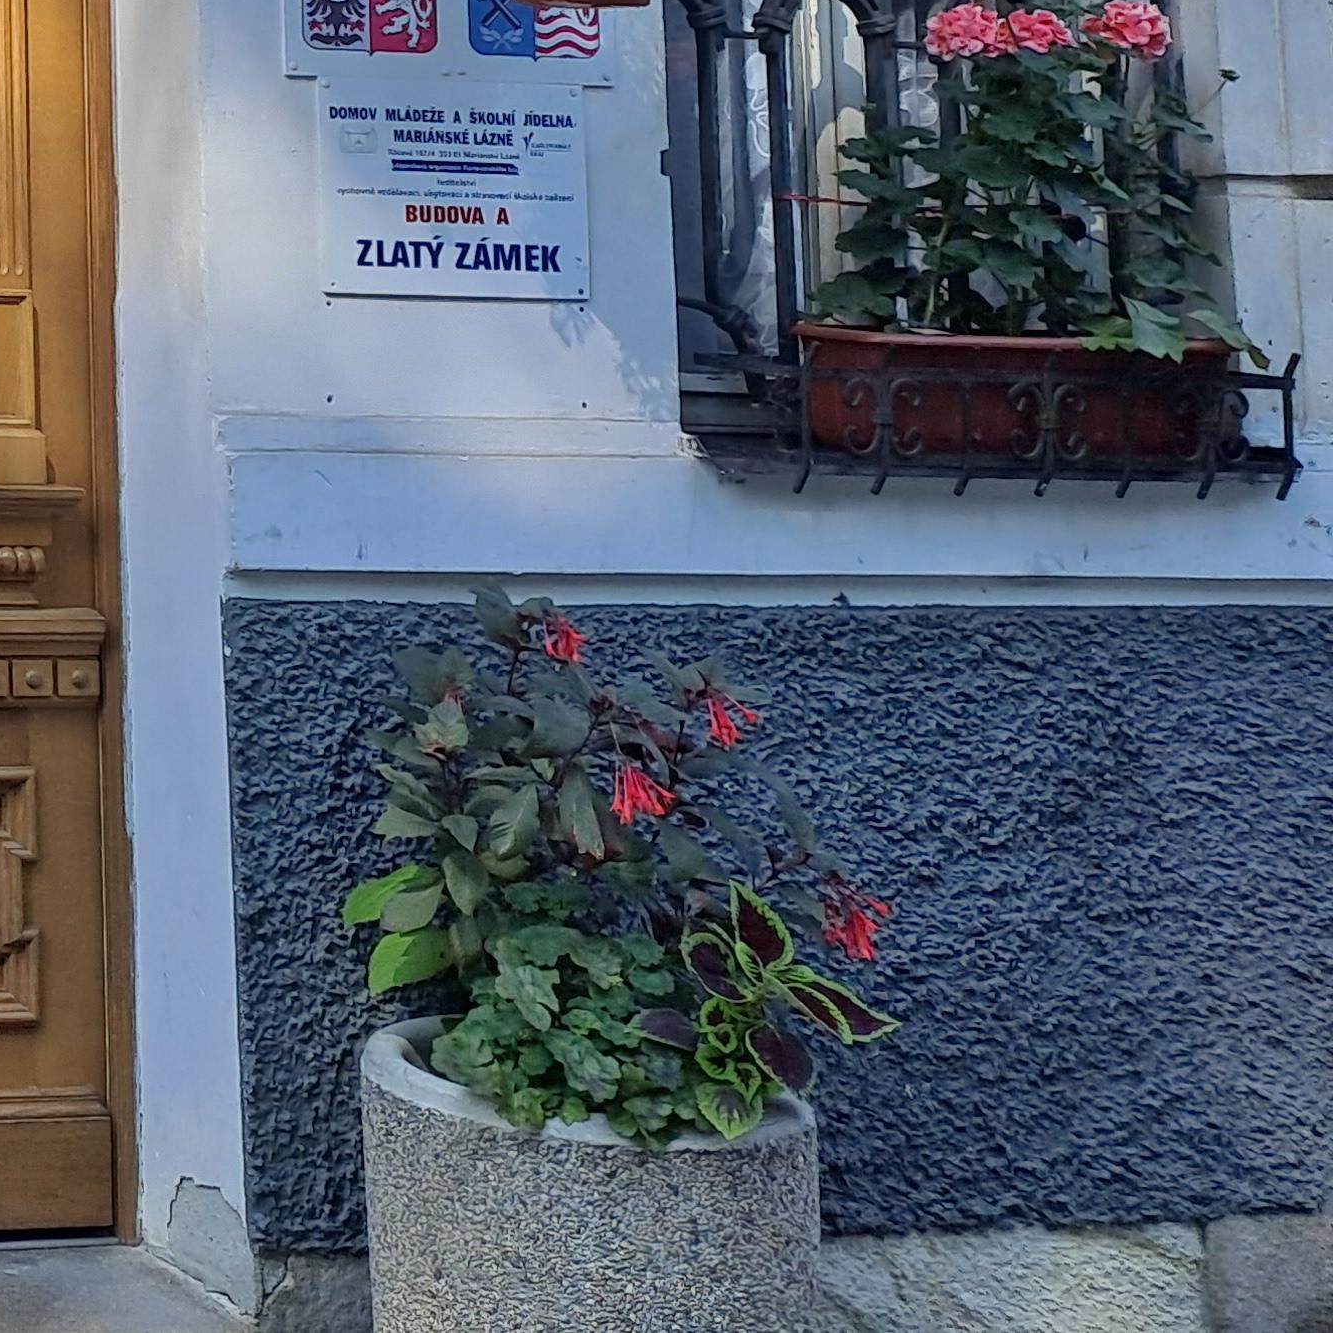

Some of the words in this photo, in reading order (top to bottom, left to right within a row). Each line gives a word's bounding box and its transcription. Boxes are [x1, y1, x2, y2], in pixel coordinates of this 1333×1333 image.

[329, 106, 377, 120] DOMOV
[385, 105, 445, 123] MLÁDEŽE
[453, 110, 461, 124] A
[469, 107, 516, 126] ŠKOLNÍ
[394, 127, 470, 145] MARIÁNSKÉ
[474, 128, 513, 147] LÁZNĚ
[405, 205, 485, 224] BUDOVA
[496, 207, 509, 225] A
[356, 235, 444, 269] ZLATÝ
[455, 237, 561, 273] ZÁMEK
